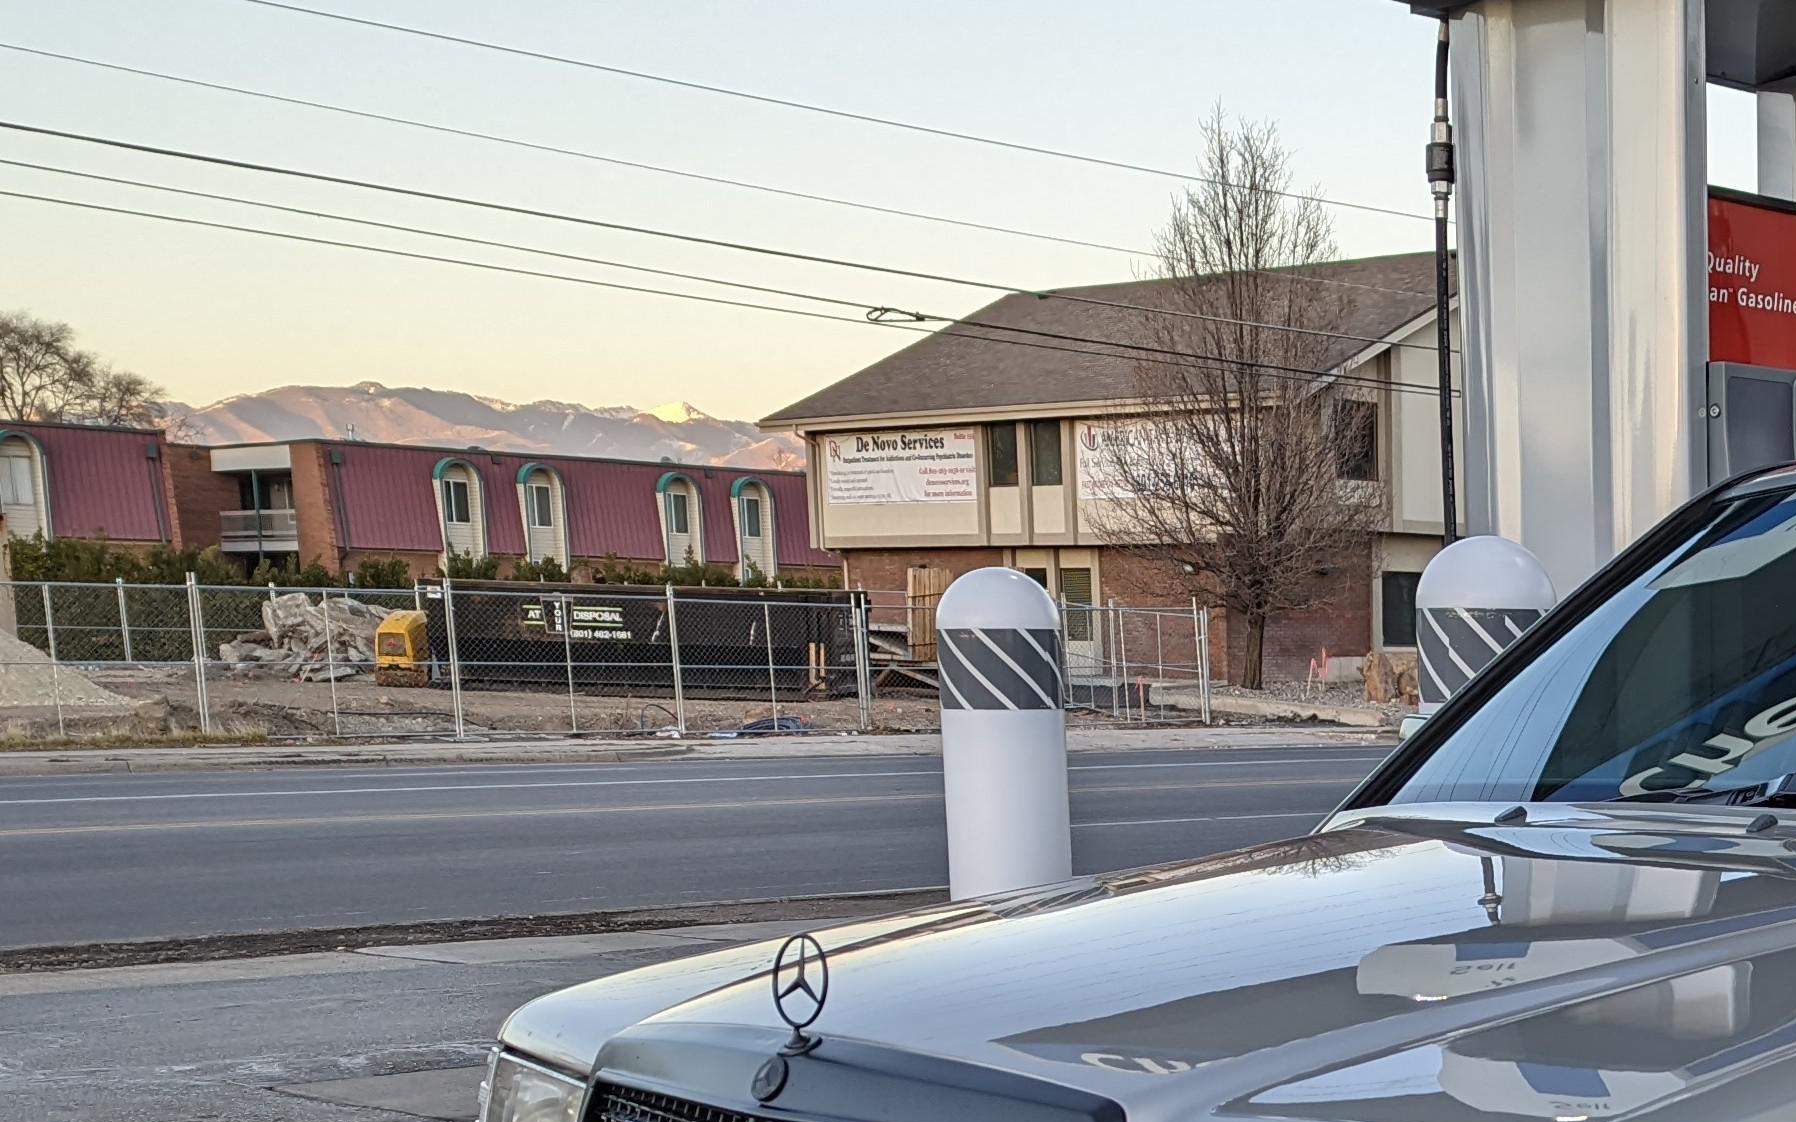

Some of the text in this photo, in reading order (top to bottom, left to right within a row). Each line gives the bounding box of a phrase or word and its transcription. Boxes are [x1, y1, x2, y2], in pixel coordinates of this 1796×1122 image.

[1707, 252, 1759, 282] Quality
[855, 433, 945, 453] De Novo Services
[528, 610, 541, 619] AT
[553, 601, 562, 632] YOUR
[573, 611, 623, 621] DISPOSAL
